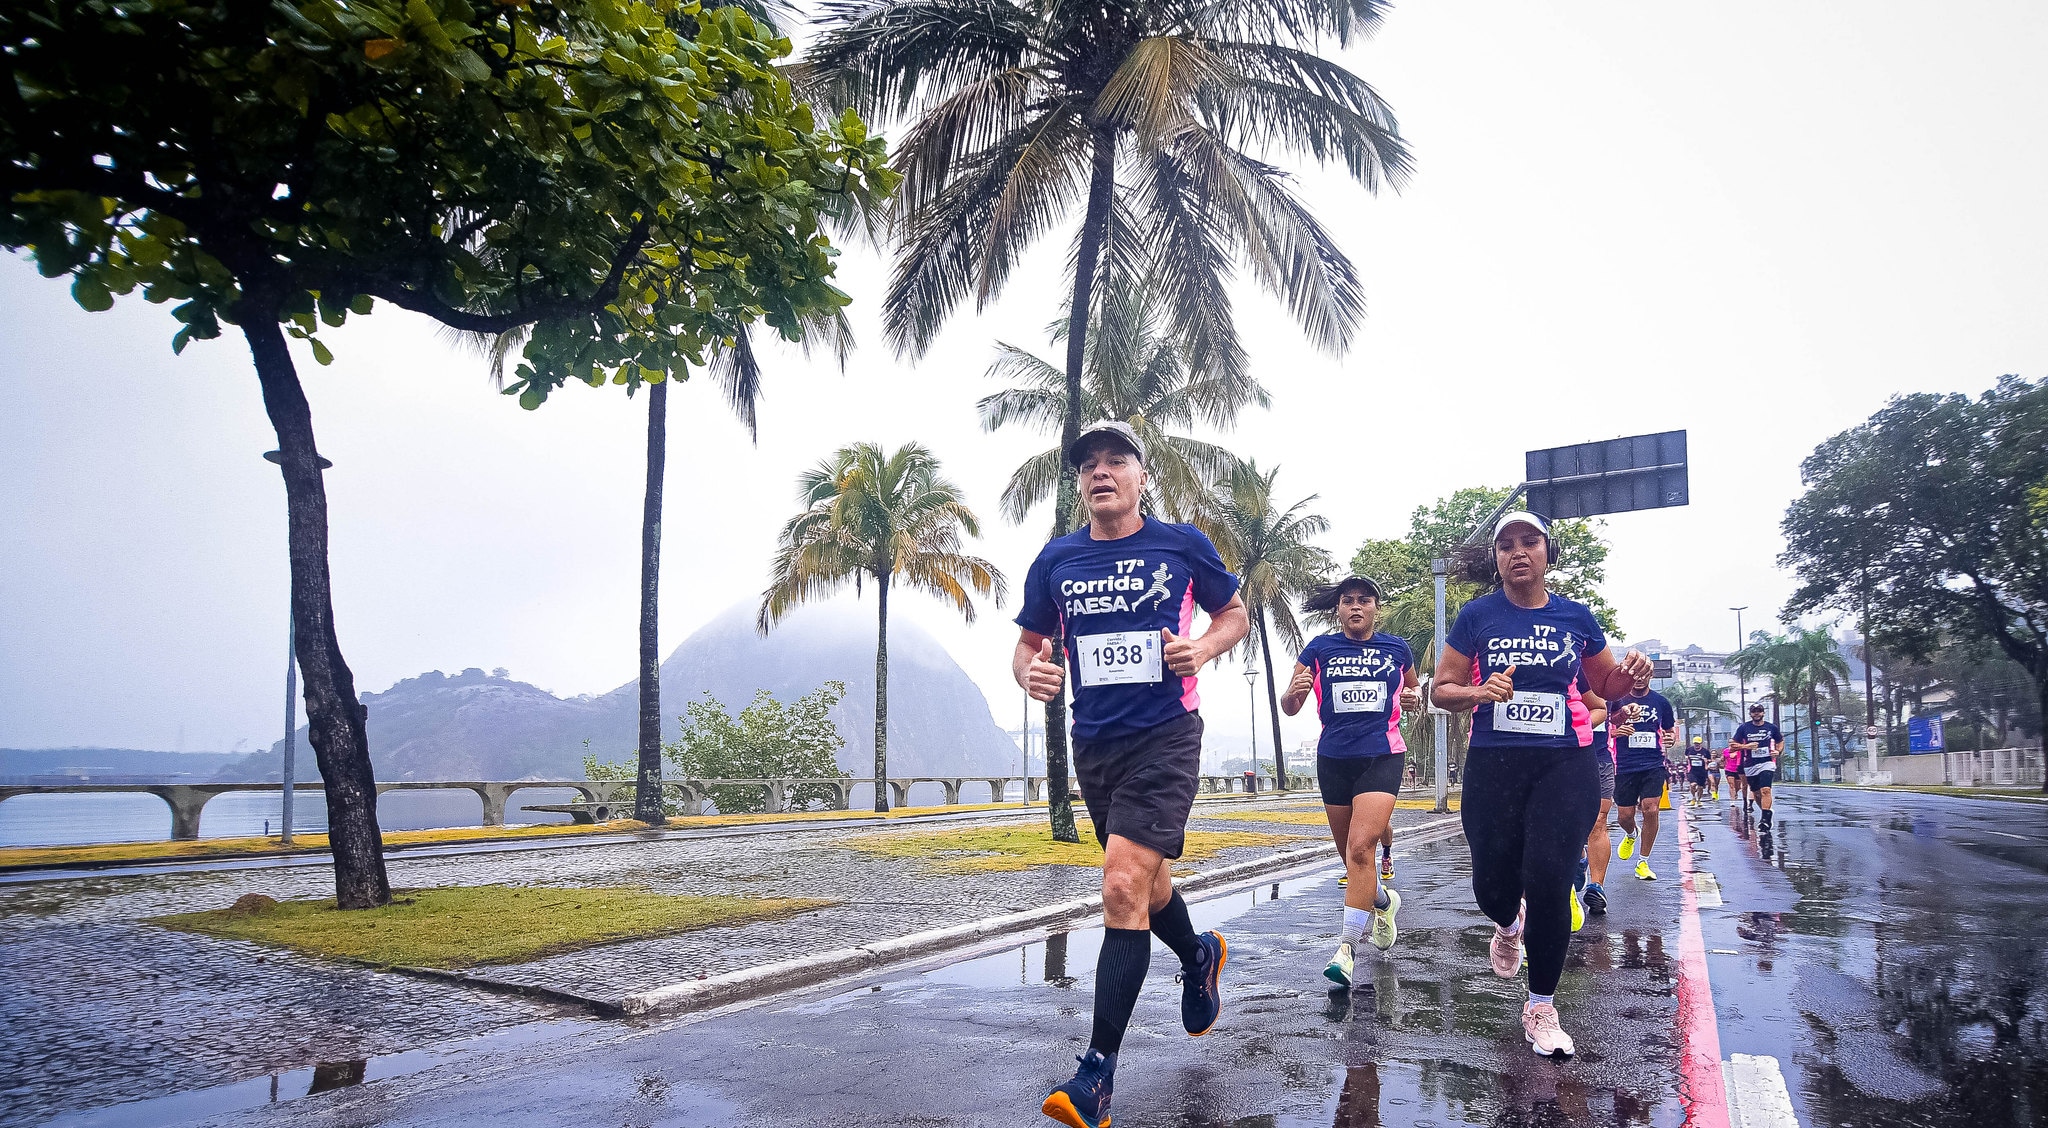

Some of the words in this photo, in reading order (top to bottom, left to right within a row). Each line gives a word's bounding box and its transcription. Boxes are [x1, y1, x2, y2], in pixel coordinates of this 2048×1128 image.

[1060, 575, 1144, 597] Corrida
[1065, 595, 1130, 618] FAESA
[1488, 635, 1559, 651] Corrida
[1092, 645, 1143, 667] 1938
[1328, 655, 1380, 666] Corrida
[1487, 651, 1548, 667] FAESA
[1326, 666, 1371, 677] FAESA
[1343, 690, 1377, 703] 3002
[1508, 704, 1552, 722] 3022
